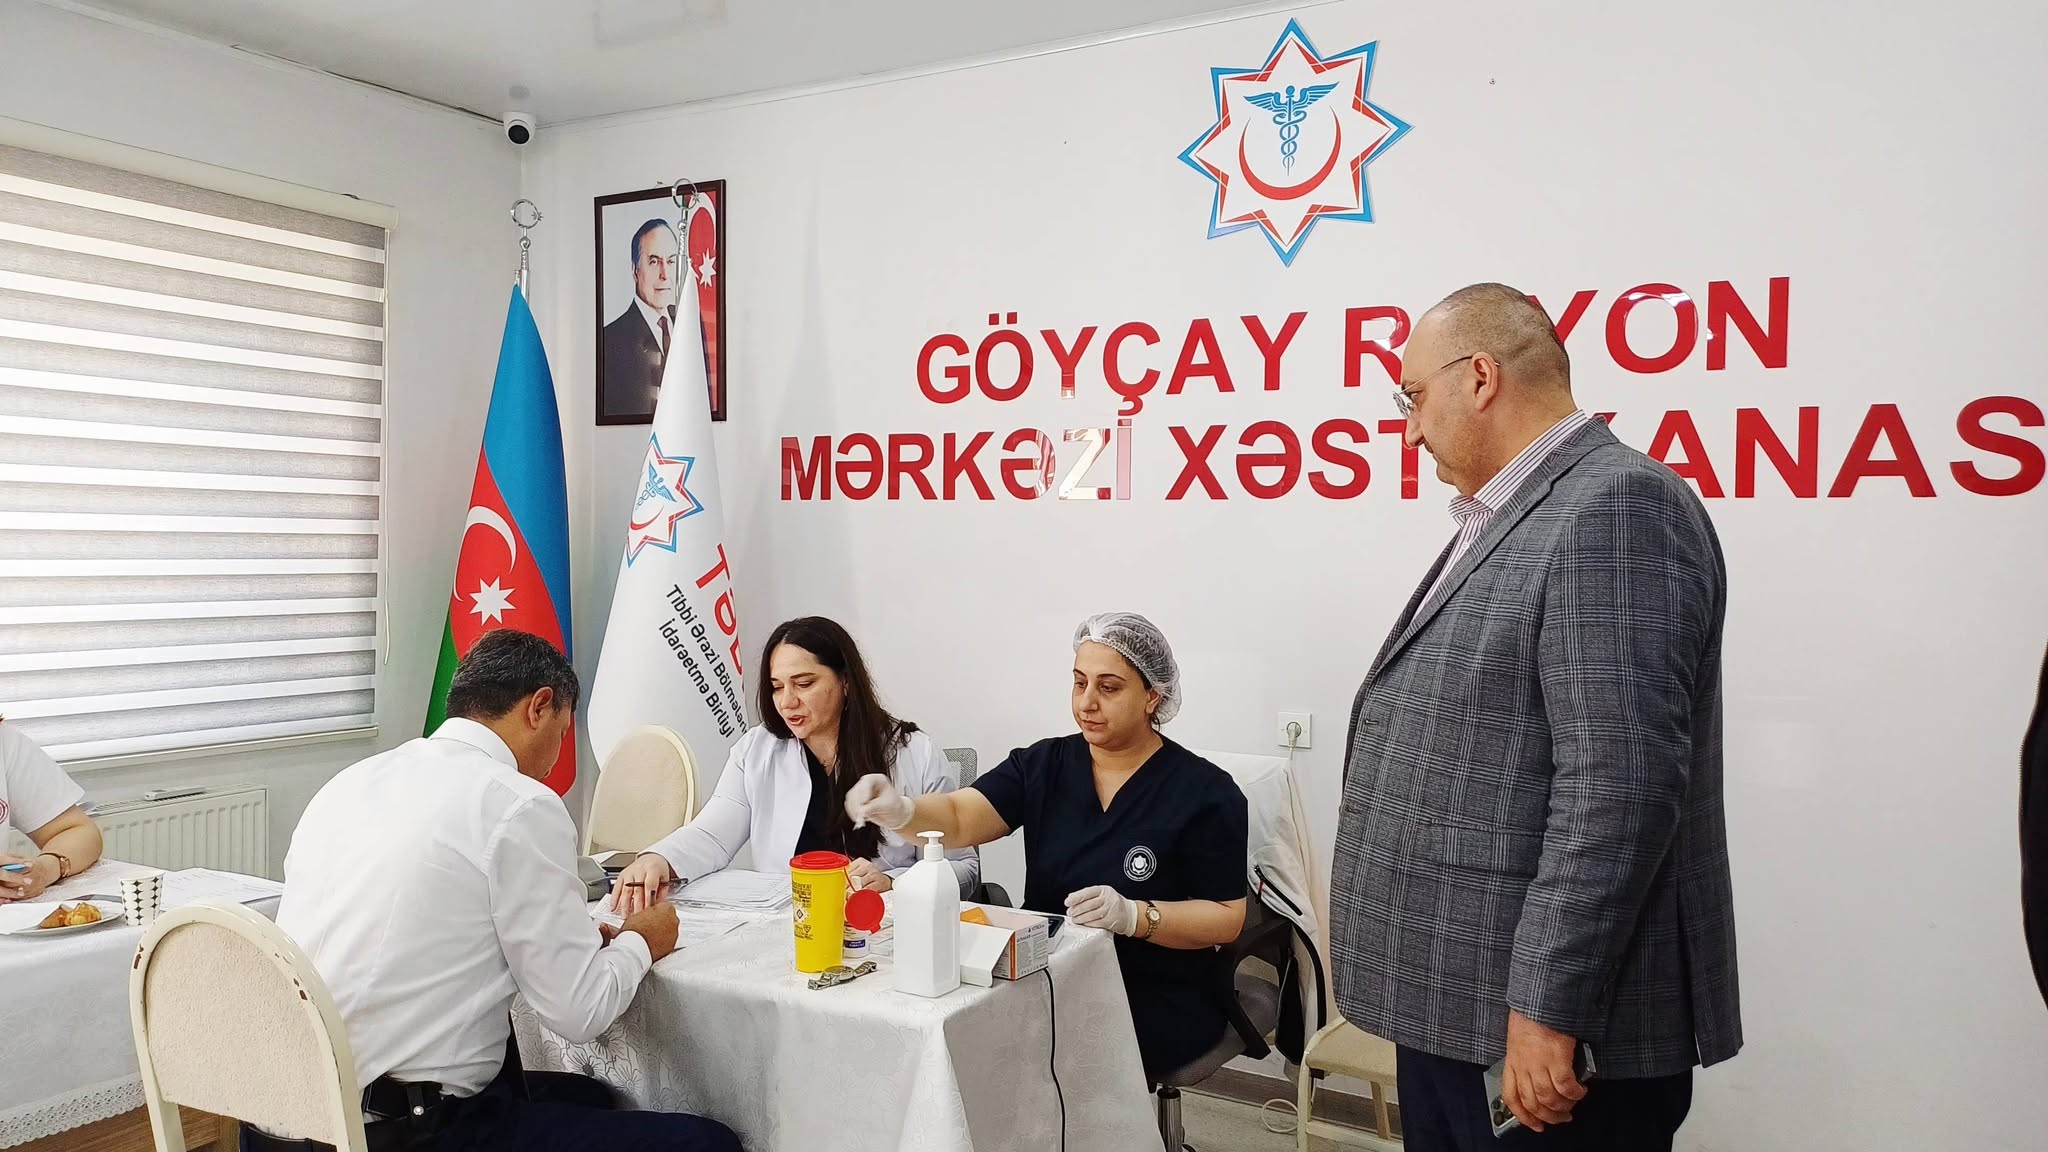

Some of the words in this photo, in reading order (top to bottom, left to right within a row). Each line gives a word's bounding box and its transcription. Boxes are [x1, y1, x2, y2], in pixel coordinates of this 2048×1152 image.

[916, 311, 1309, 416] GÖYÇAY
[780, 418, 1136, 500] MƏRKƏZİ
[666, 584, 698, 625] Tibbi
[690, 623, 720, 665] Ərazi
[658, 618, 709, 694] İdarəetmə
[705, 692, 735, 738] Birliyi
